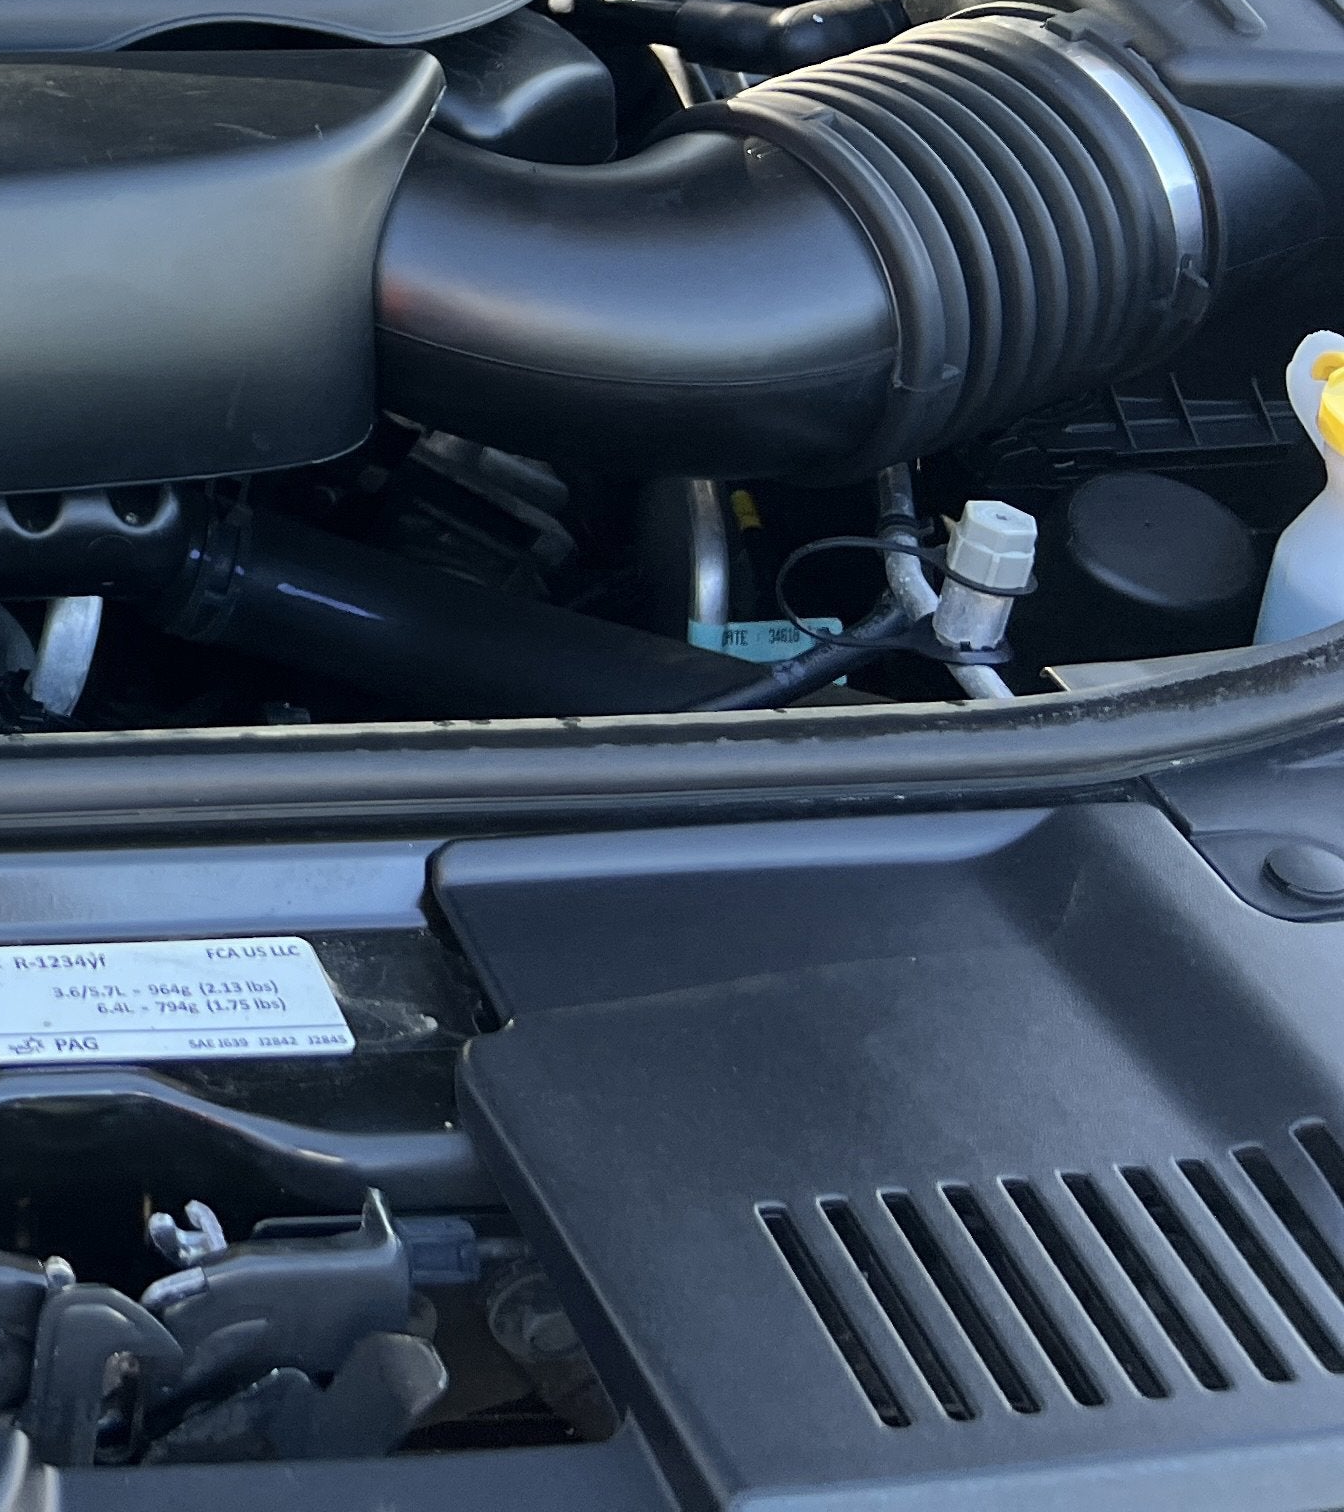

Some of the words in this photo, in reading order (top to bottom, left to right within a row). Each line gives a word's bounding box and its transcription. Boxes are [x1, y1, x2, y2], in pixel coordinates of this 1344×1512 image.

[14, 952, 106, 971] R-1234yf
[207, 947, 240, 960] FCA
[243, 946, 268, 959] US
[270, 945, 300, 958] LLC
[52, 984, 126, 1000] 3.6/5.7L
[148, 983, 190, 999] 964g
[200, 981, 240, 997] (2.13
[245, 979, 279, 995] lbs)
[97, 1000, 134, 1015] 6.4L
[156, 999, 199, 1015] 794g
[207, 998, 250, 1014] (1.75
[254, 996, 287, 1012] lbs)
[55, 1037, 100, 1051] PAG
